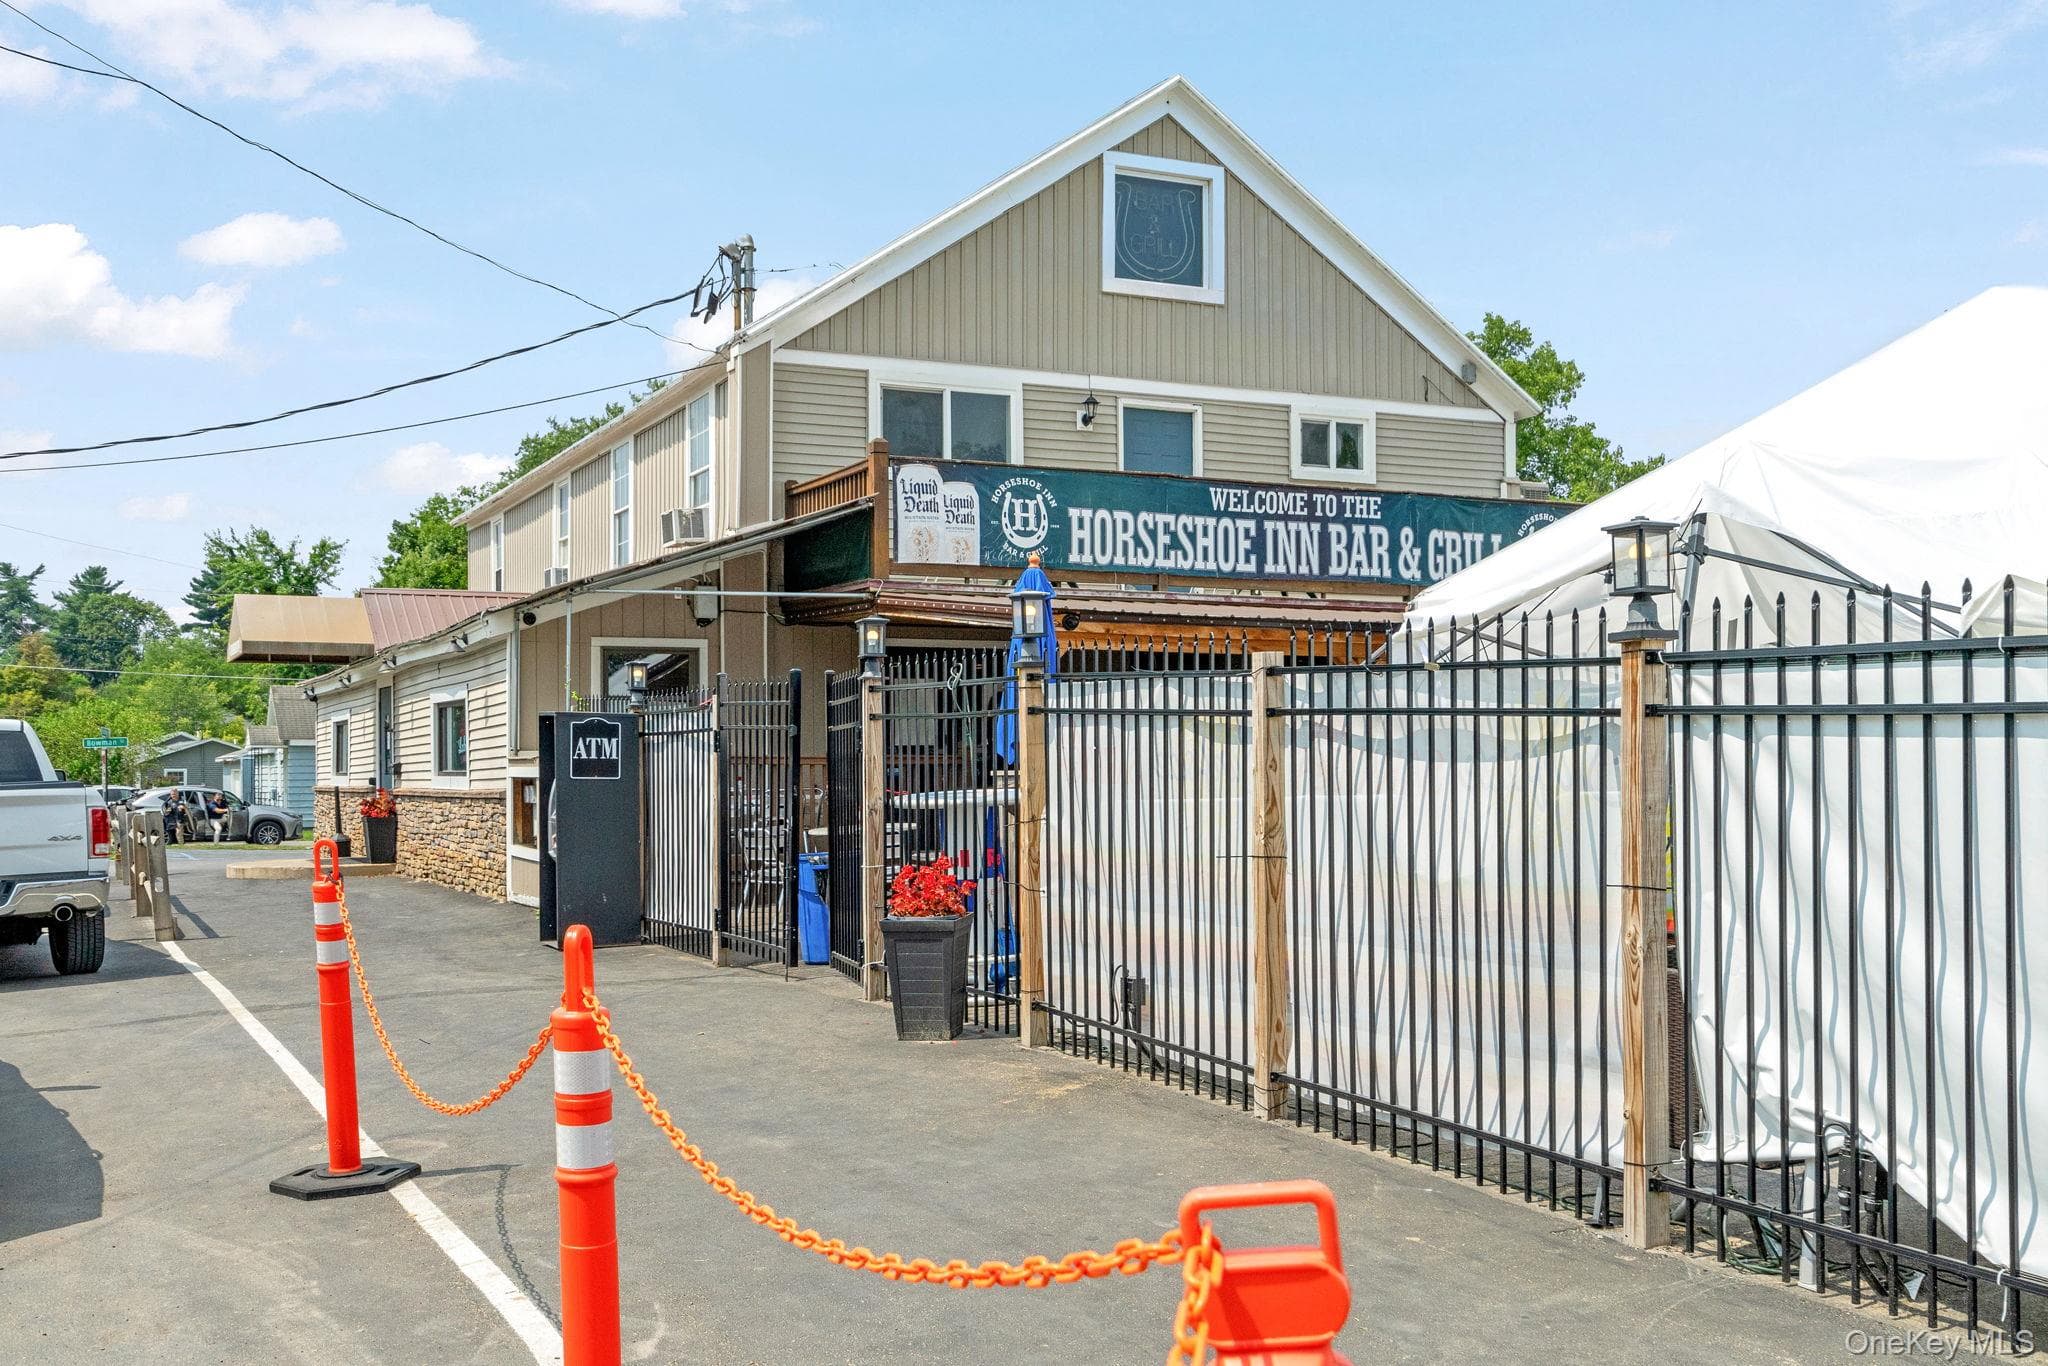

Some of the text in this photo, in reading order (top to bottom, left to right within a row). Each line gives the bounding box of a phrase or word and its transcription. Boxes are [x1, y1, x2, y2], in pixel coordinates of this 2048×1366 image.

[900, 478, 938, 499] Liquid
[991, 477, 1058, 508] HORSESHOE INN
[904, 495, 939, 513] Death
[943, 494, 975, 512] Liquid
[1209, 487, 1382, 519] WELCOME TO THE
[945, 509, 976, 525] Death
[1011, 498, 1039, 531] H
[1517, 513, 1559, 537] HORSESHO
[1002, 542, 1018, 557] BAR
[1026, 545, 1049, 558] GILL
[1067, 506, 1257, 573] HORSESHOE
[1263, 520, 1321, 575] INN
[1328, 522, 1392, 578] BAR
[1398, 526, 1422, 580] &
[86, 739, 117, 747] Bowman
[572, 736, 619, 760] ATM
